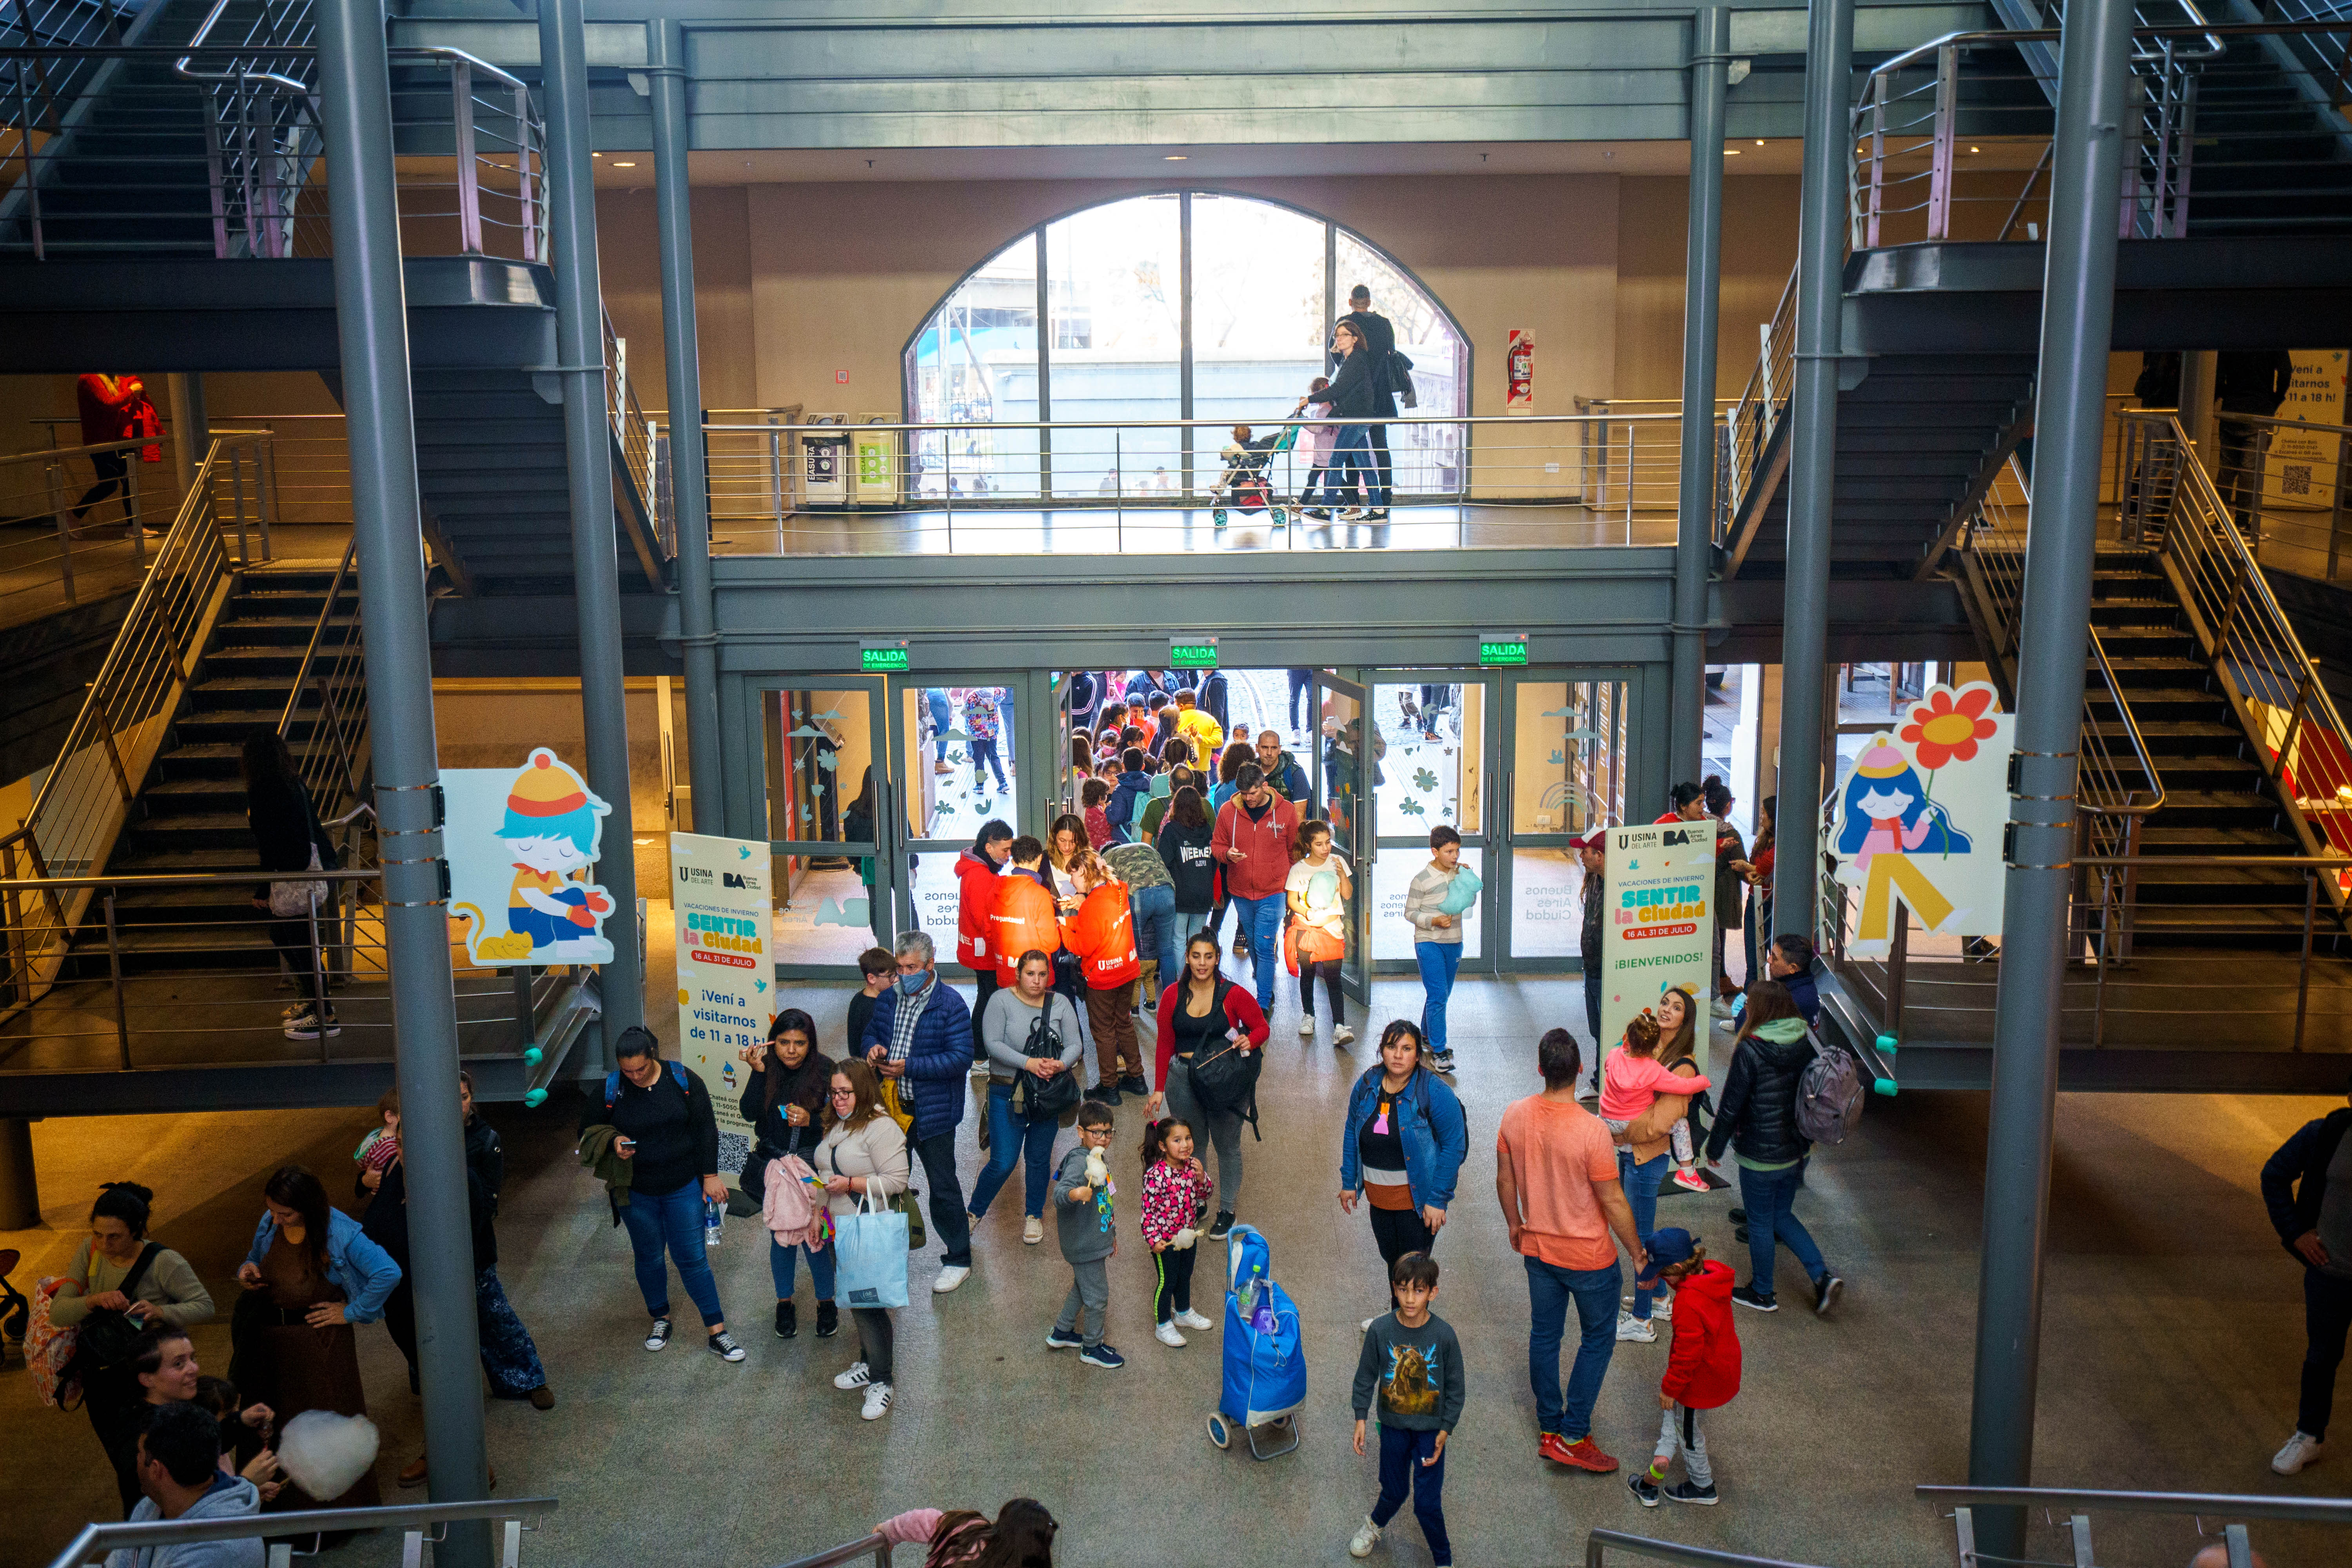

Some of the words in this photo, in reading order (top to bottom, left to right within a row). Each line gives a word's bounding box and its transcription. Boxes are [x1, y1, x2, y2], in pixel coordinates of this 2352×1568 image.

[2292, 379, 2329, 388] itarnos
[2289, 393, 2297, 401] 11
[2311, 394, 2321, 402] 18
[2326, 394, 2336, 402] h!
[1172, 648, 1216, 659] SALIDA
[1482, 645, 1526, 655] SALIDA
[863, 651, 907, 662] SALIDA
[1632, 833, 1657, 842] USINA
[1663, 829, 1690, 847] BA
[1180, 846, 1212, 863] WEEKE
[691, 868, 713, 878] USINA
[723, 873, 746, 889] BA
[1618, 878, 1661, 887] VACACIONES
[1622, 885, 1700, 908] SENTIR
[684, 903, 720, 912] VACACIONES
[731, 909, 759, 917] INVIERNO
[1615, 908, 1633, 925] la
[1638, 900, 1705, 922] Ciudad
[688, 913, 756, 938] SENTIR
[683, 928, 699, 946] la
[703, 931, 762, 954] Ciudad
[732, 958, 751, 967] JULIO
[1106, 956, 1123, 966] USINA
[1615, 953, 1702, 969] ¡BIENVENIDOS!
[702, 989, 734, 1005] ¡Vení
[738, 997, 745, 1007] a
[693, 1008, 756, 1028] visitarnos
[690, 1026, 706, 1039] de
[710, 1029, 719, 1042] 11
[724, 1034, 731, 1044] a
[736, 1034, 749, 1046] 18
[716, 1102, 739, 1111] 11-5050-
[726, 1120, 755, 1129] programac
